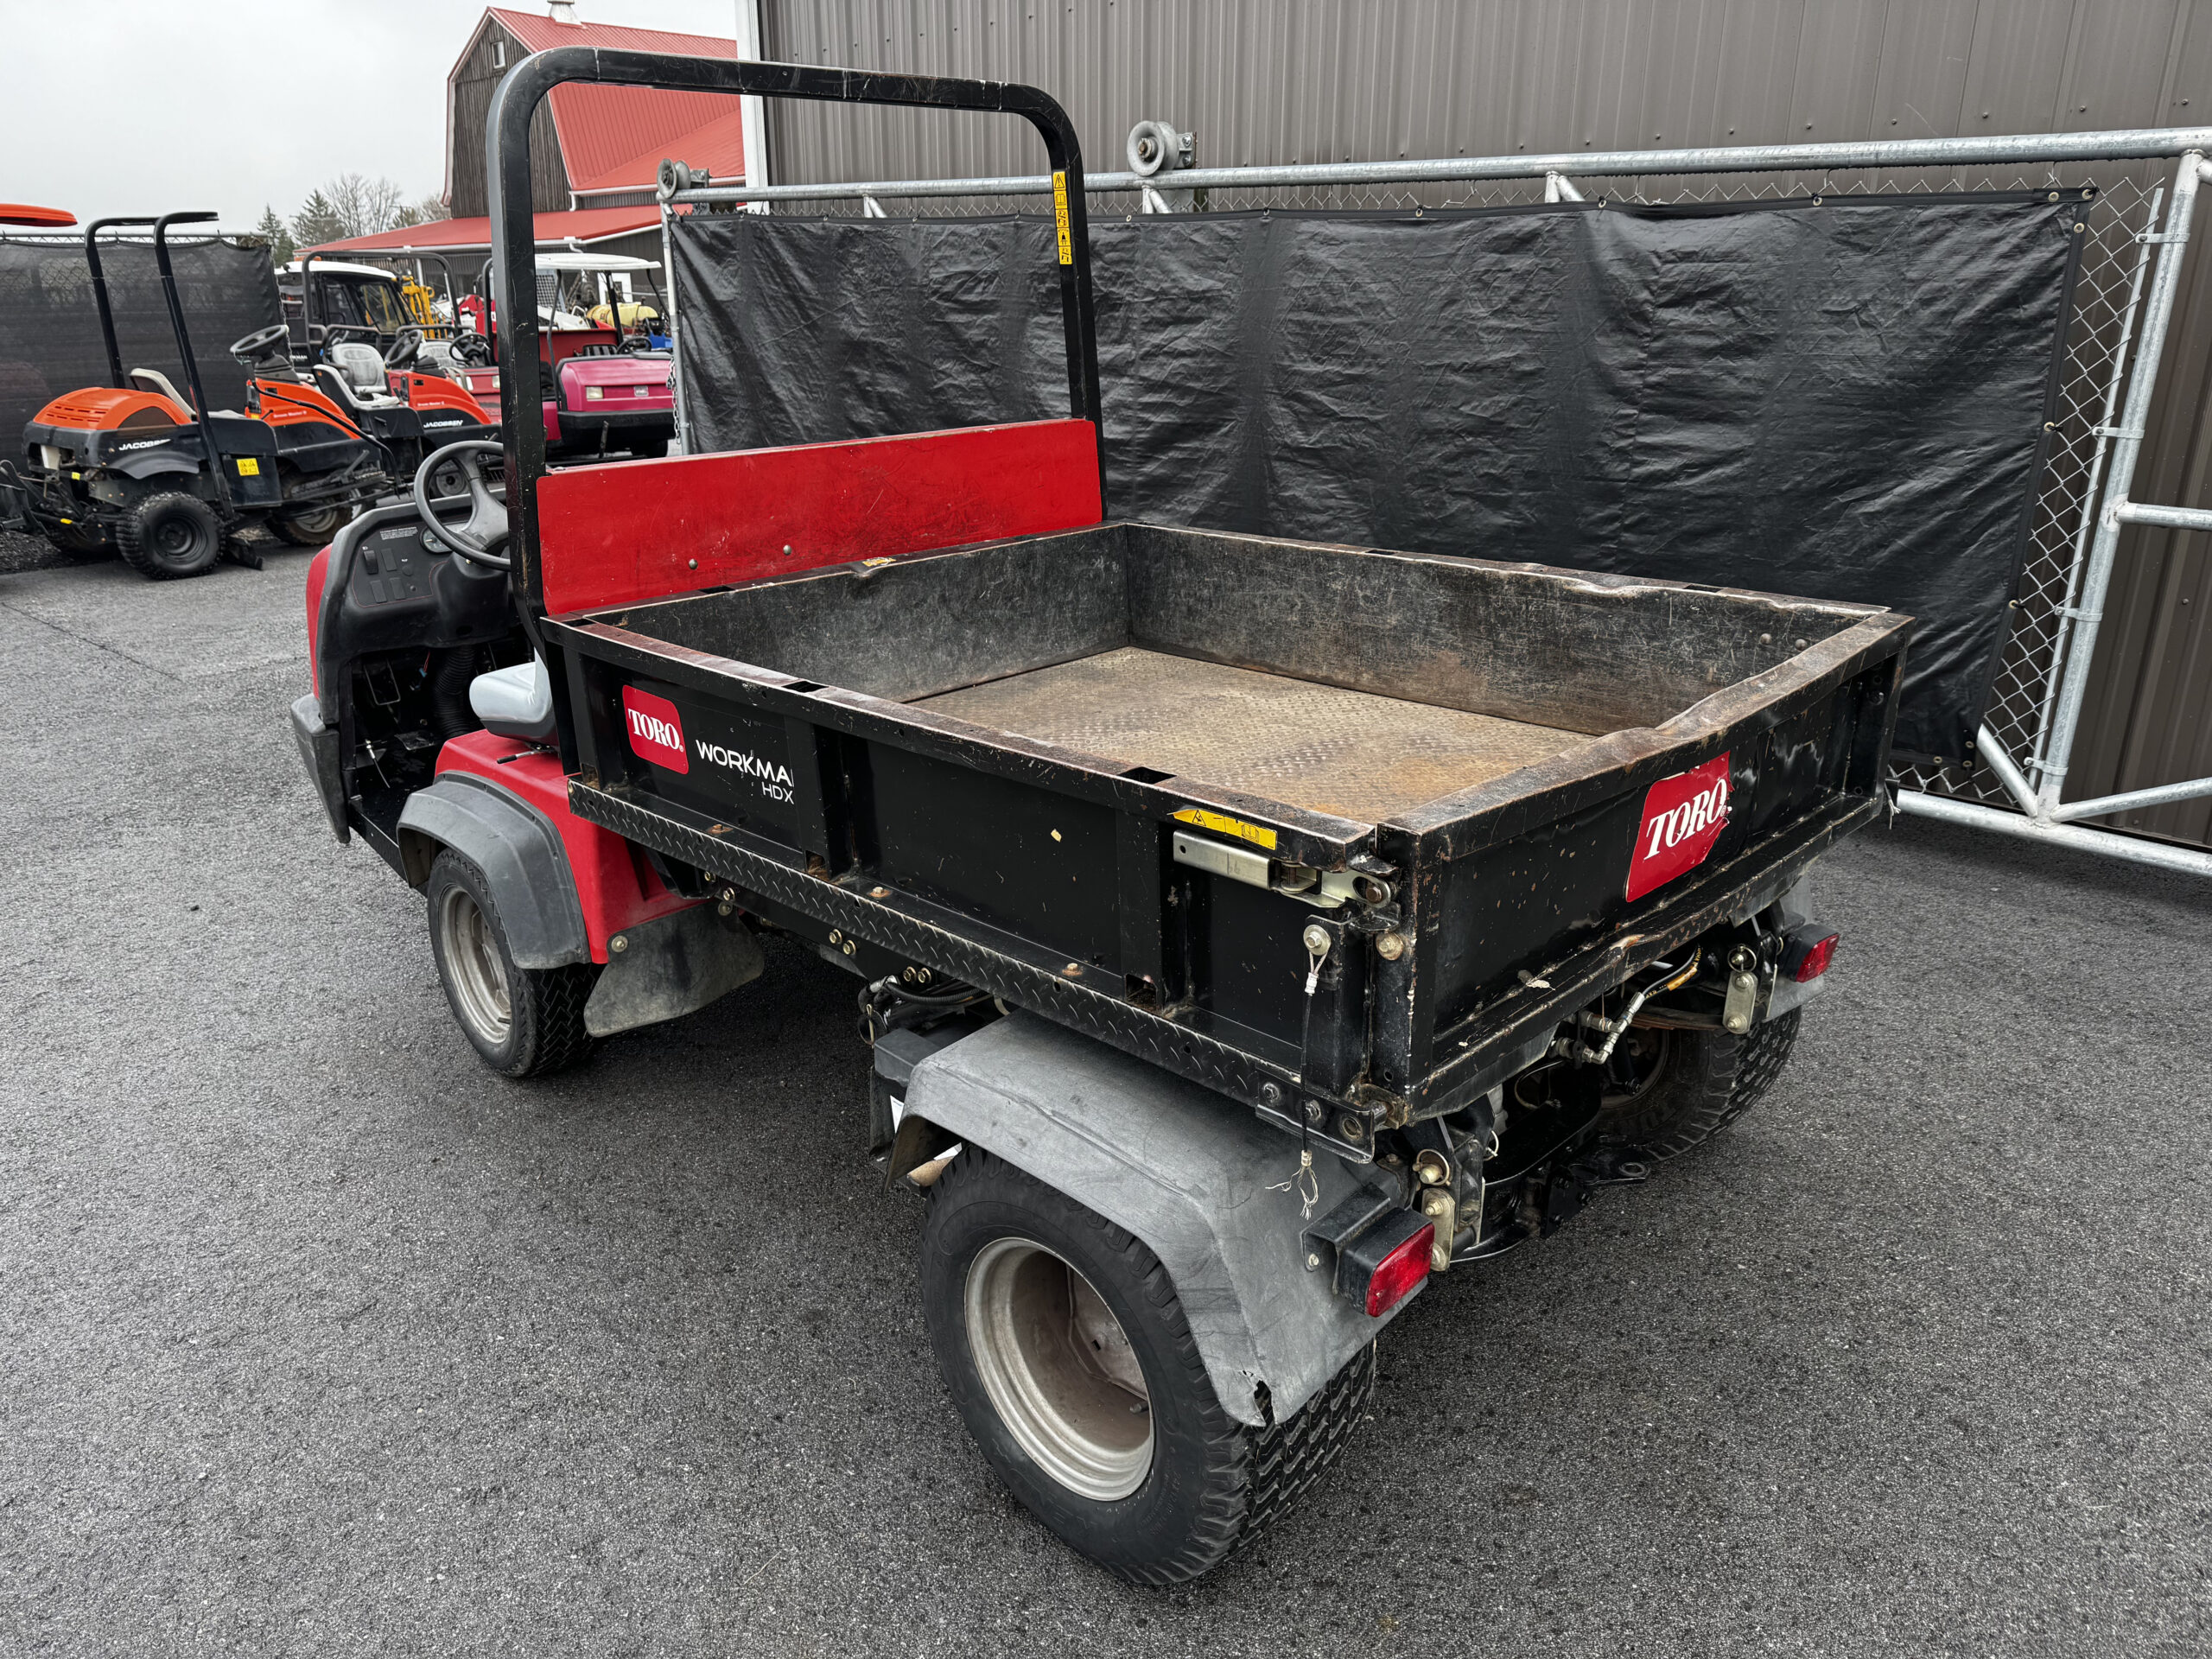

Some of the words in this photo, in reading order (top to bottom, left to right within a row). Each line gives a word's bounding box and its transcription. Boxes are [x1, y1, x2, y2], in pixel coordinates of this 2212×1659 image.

[696, 739, 794, 787] WORKMA
[762, 781, 794, 804] HDX
[1643, 779, 1727, 861] TORO
